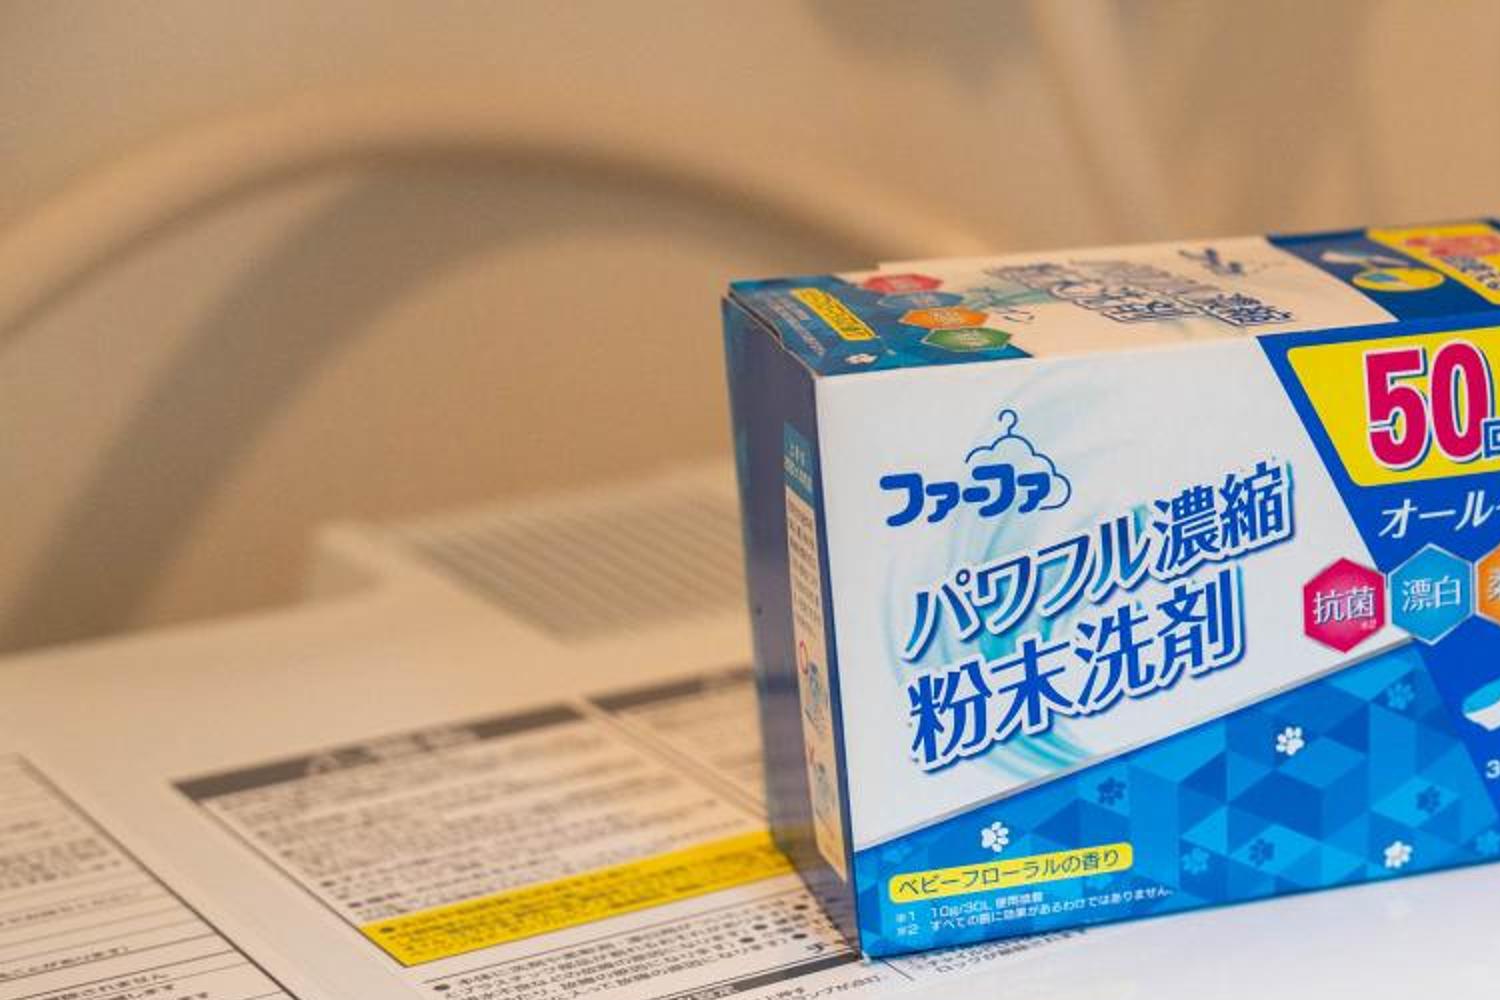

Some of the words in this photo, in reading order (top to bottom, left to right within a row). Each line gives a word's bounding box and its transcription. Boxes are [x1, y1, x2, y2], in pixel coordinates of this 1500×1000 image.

[880, 463, 1052, 527] ファーファ
[903, 461, 1288, 661] パワフル濃縮
[1312, 585, 1376, 625] 抗菌
[1402, 575, 1461, 613] 漂白
[907, 565, 1244, 768] 粉末洗剤
[897, 847, 1121, 897] ベビーフローラルの香り
